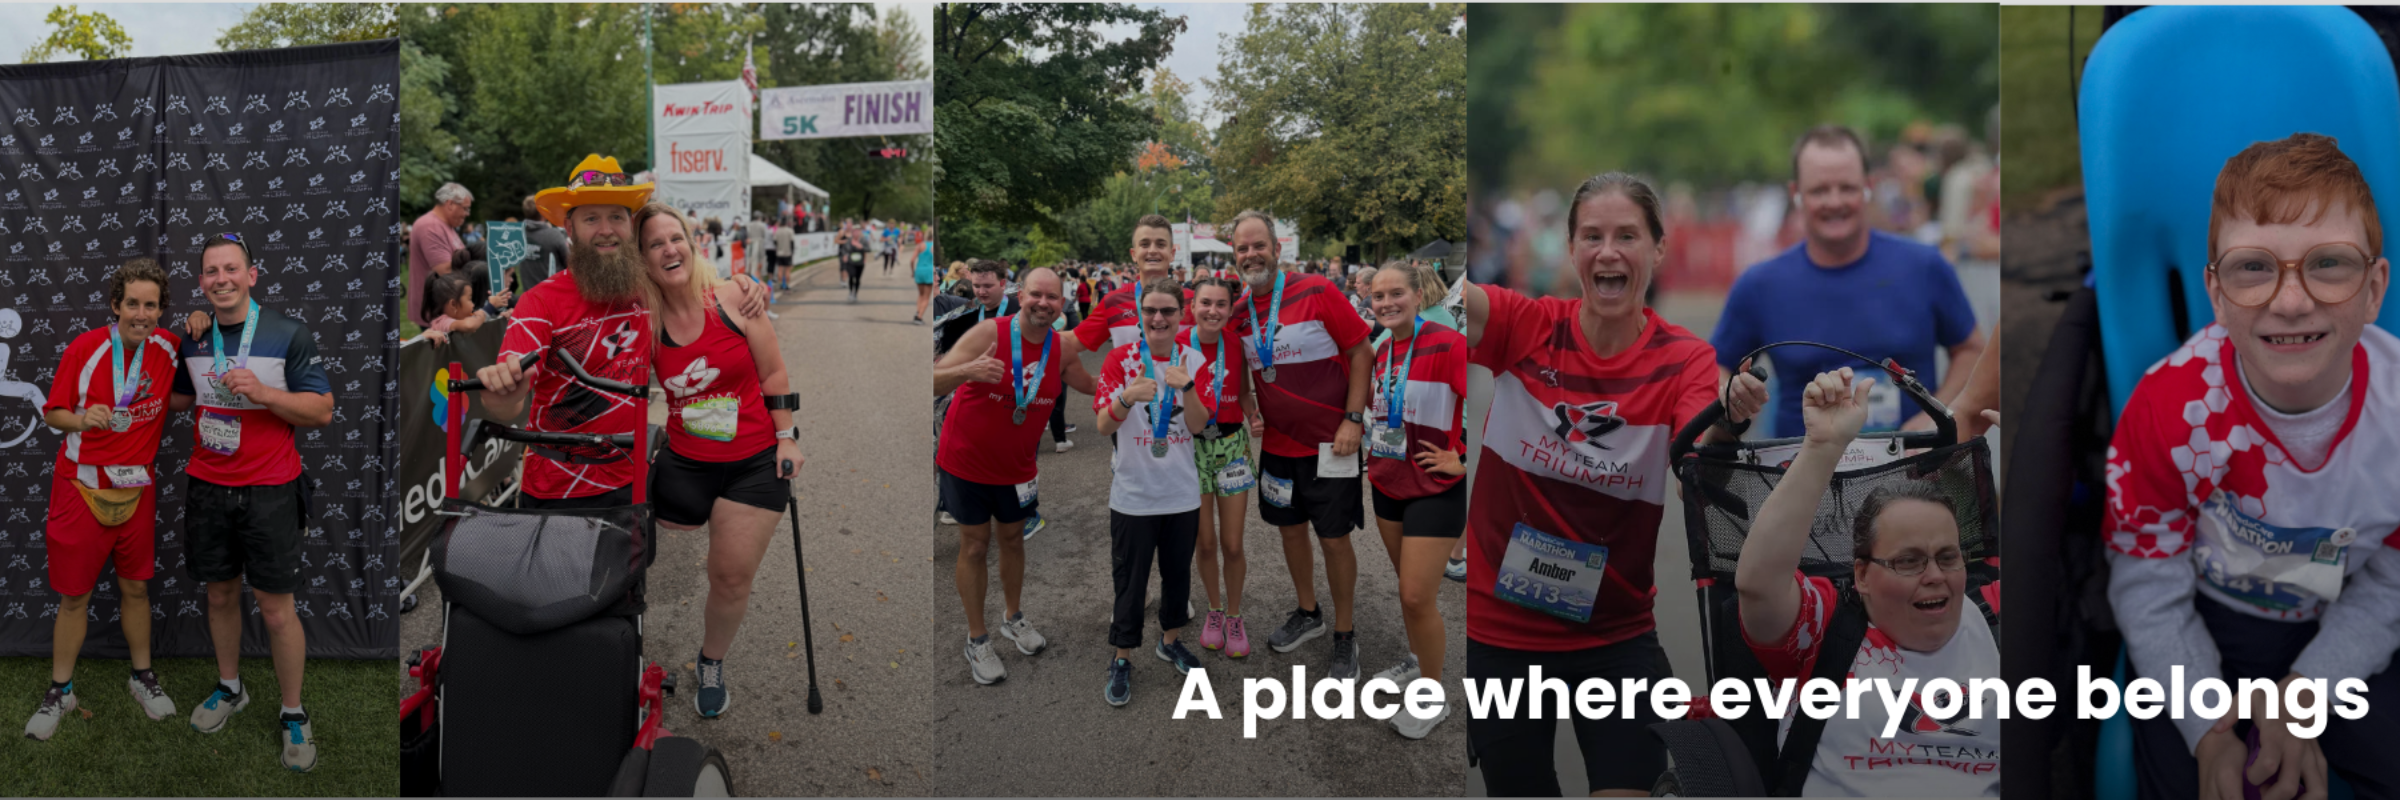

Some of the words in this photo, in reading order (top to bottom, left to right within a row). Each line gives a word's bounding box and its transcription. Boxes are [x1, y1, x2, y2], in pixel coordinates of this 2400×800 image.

[844, 91, 921, 125] FINISH
[783, 115, 818, 134] 5K
[677, 198, 730, 209] Guardian
[1520, 440, 1643, 490] TRIUMPH
[1520, 533, 1576, 559] MARATHON
[1529, 557, 1576, 582] Amber
[1499, 572, 1560, 604] 4213
